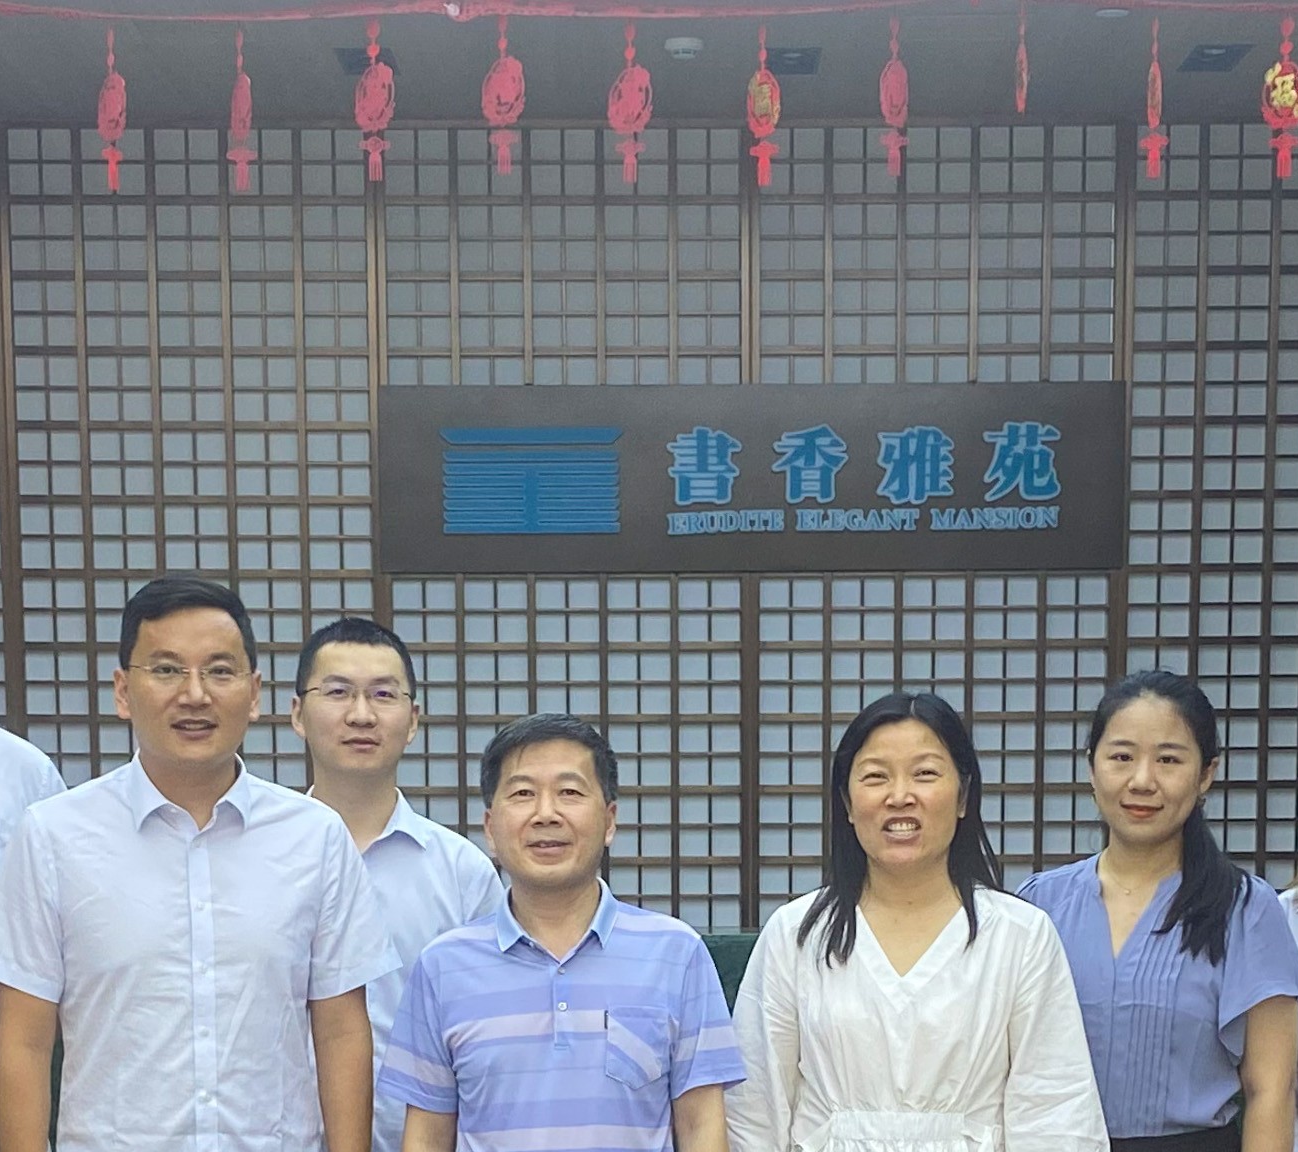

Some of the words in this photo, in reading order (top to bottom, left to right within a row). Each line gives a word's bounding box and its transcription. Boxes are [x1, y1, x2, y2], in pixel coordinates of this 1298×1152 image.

[667, 421, 1062, 505] 書香雅苑
[667, 511, 785, 535] ERUDITE
[795, 508, 920, 533] ELEGANT
[930, 505, 1060, 531] MANSION
